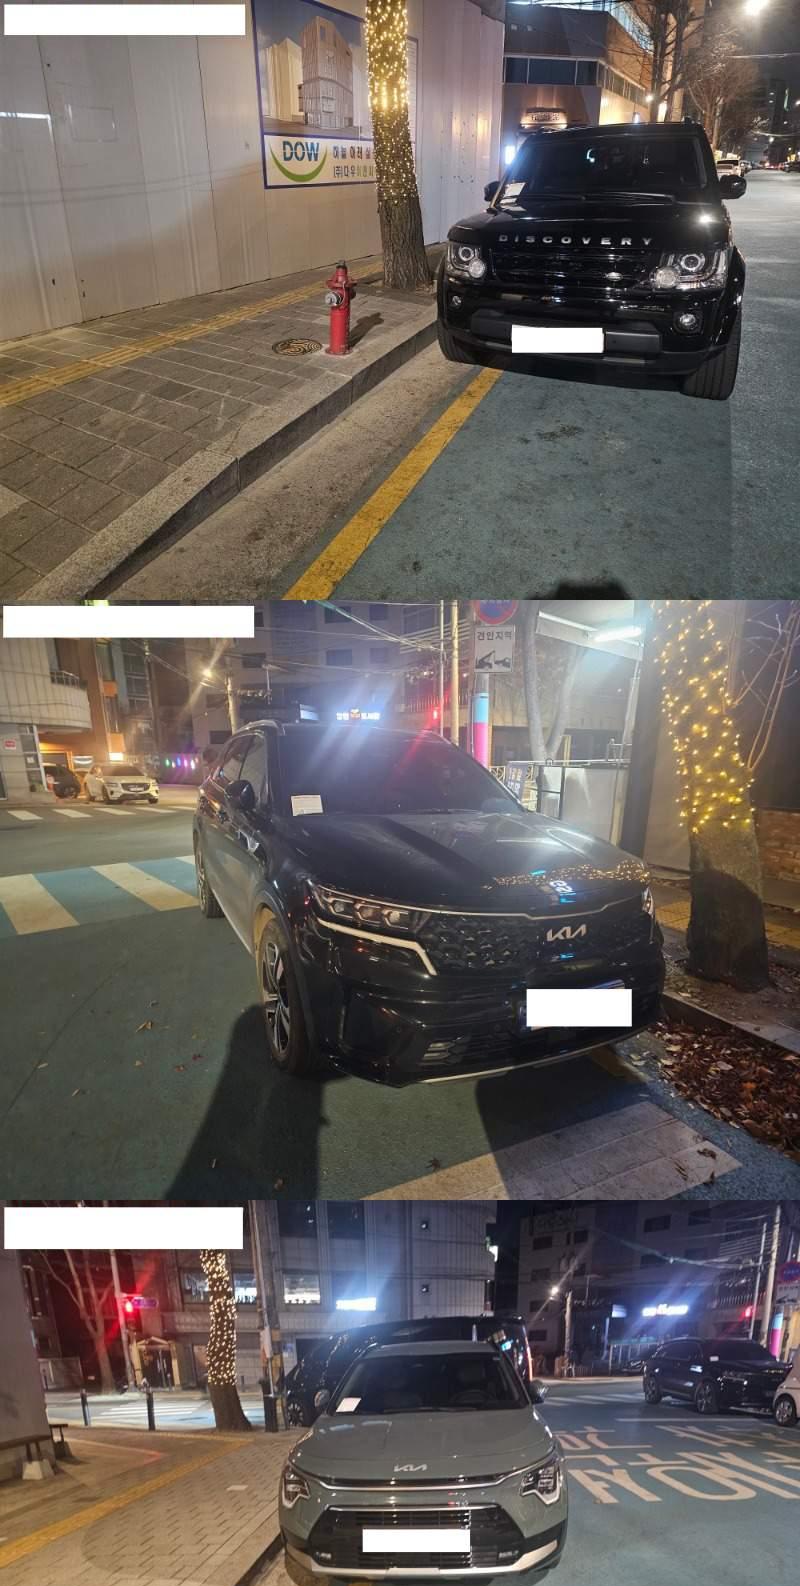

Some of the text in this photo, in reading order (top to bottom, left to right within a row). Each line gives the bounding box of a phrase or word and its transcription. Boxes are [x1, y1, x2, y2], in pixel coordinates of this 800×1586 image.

[282, 140, 320, 162] DOW
[498, 234, 652, 246] DISCOVERY
[477, 631, 512, 641] 견인지역
